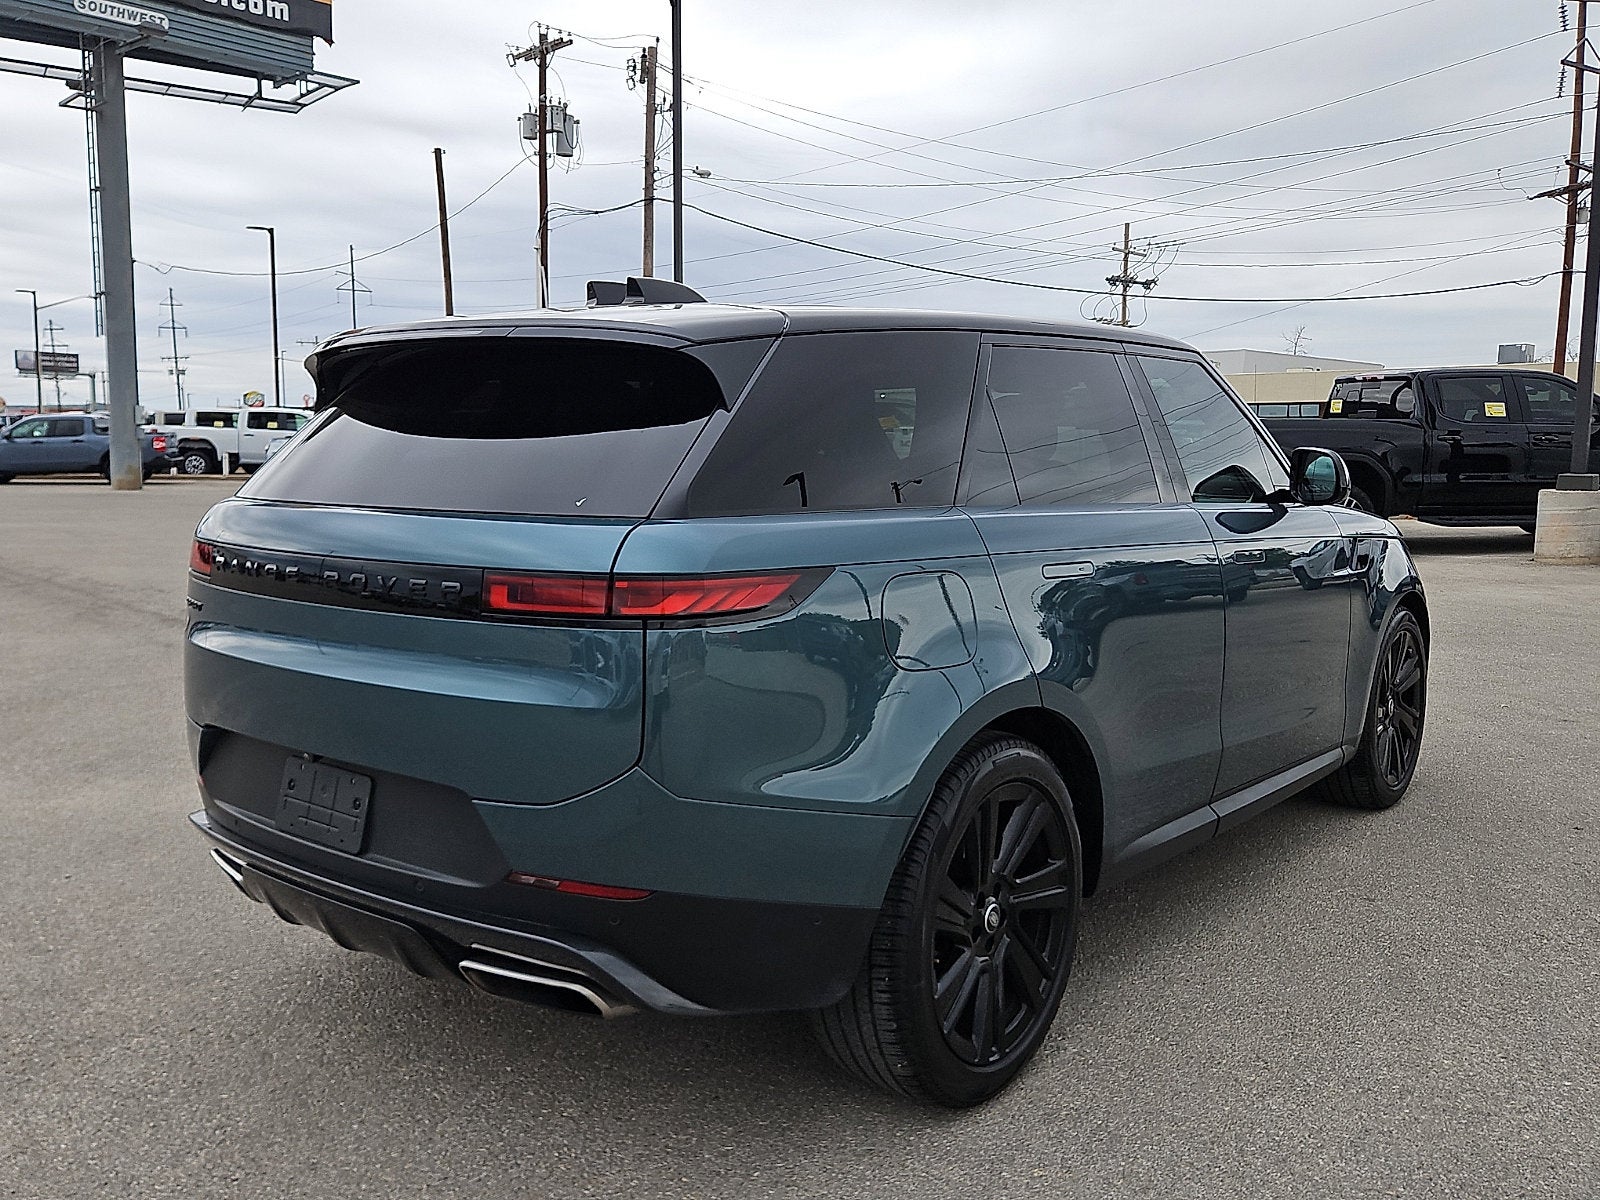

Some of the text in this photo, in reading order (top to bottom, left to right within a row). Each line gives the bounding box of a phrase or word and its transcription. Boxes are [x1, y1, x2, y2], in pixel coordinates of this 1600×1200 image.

[77, 0, 165, 25] SOUTHWEST
[204, 0, 289, 21] .com
[214, 555, 463, 601] RANGE ROVER
